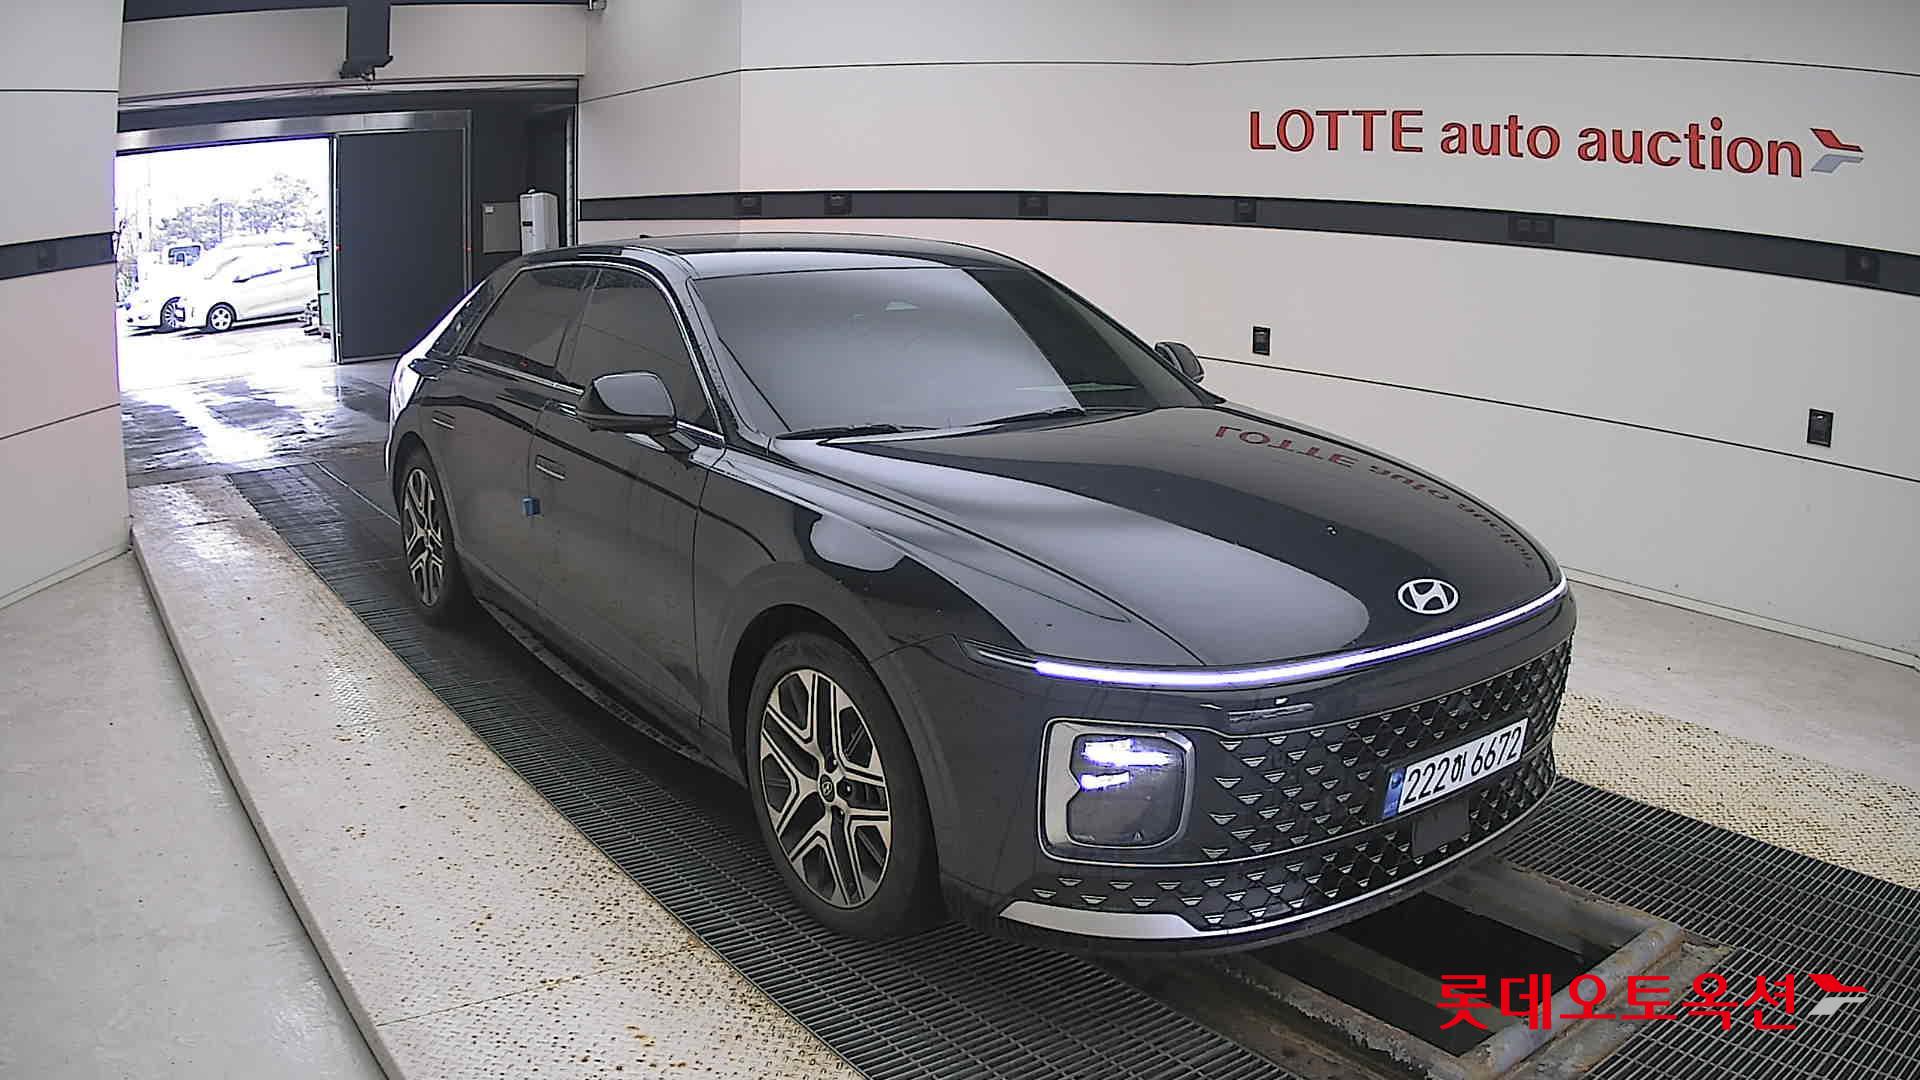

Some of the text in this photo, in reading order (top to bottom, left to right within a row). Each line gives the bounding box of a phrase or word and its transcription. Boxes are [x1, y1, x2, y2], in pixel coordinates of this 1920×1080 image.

[1249, 110, 1803, 178] LOTTE auto auction
[1471, 726, 1522, 776] 6672
